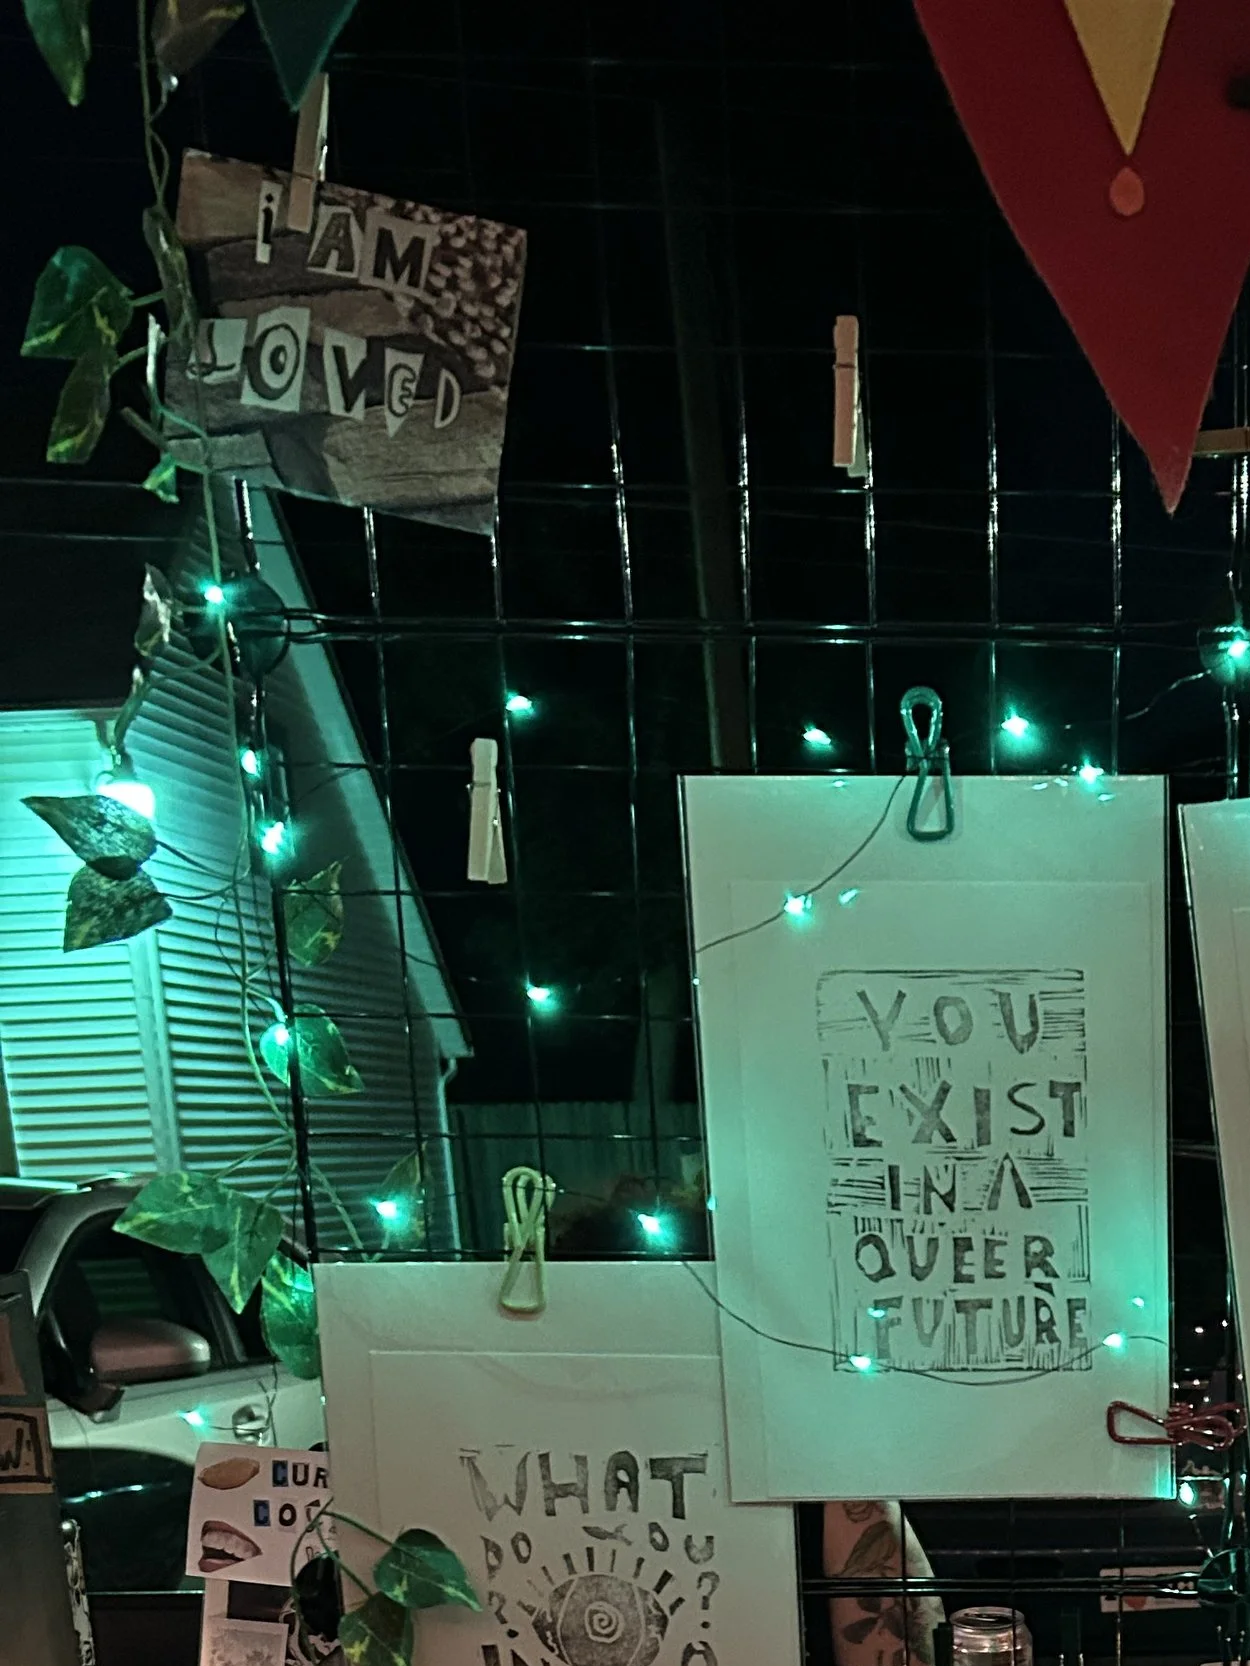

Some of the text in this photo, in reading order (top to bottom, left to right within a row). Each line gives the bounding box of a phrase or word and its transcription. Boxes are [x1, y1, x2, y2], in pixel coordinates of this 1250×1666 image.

[319, 208, 426, 283] AM
[188, 321, 461, 428] LOVED
[856, 990, 1041, 1054] YOU
[847, 1080, 1082, 1148] EXIST
[886, 1153, 1034, 1216] IN A
[855, 1233, 1061, 1285] QUEER
[871, 1297, 1089, 1360] FUTURE
[459, 1450, 709, 1522] WHAT
